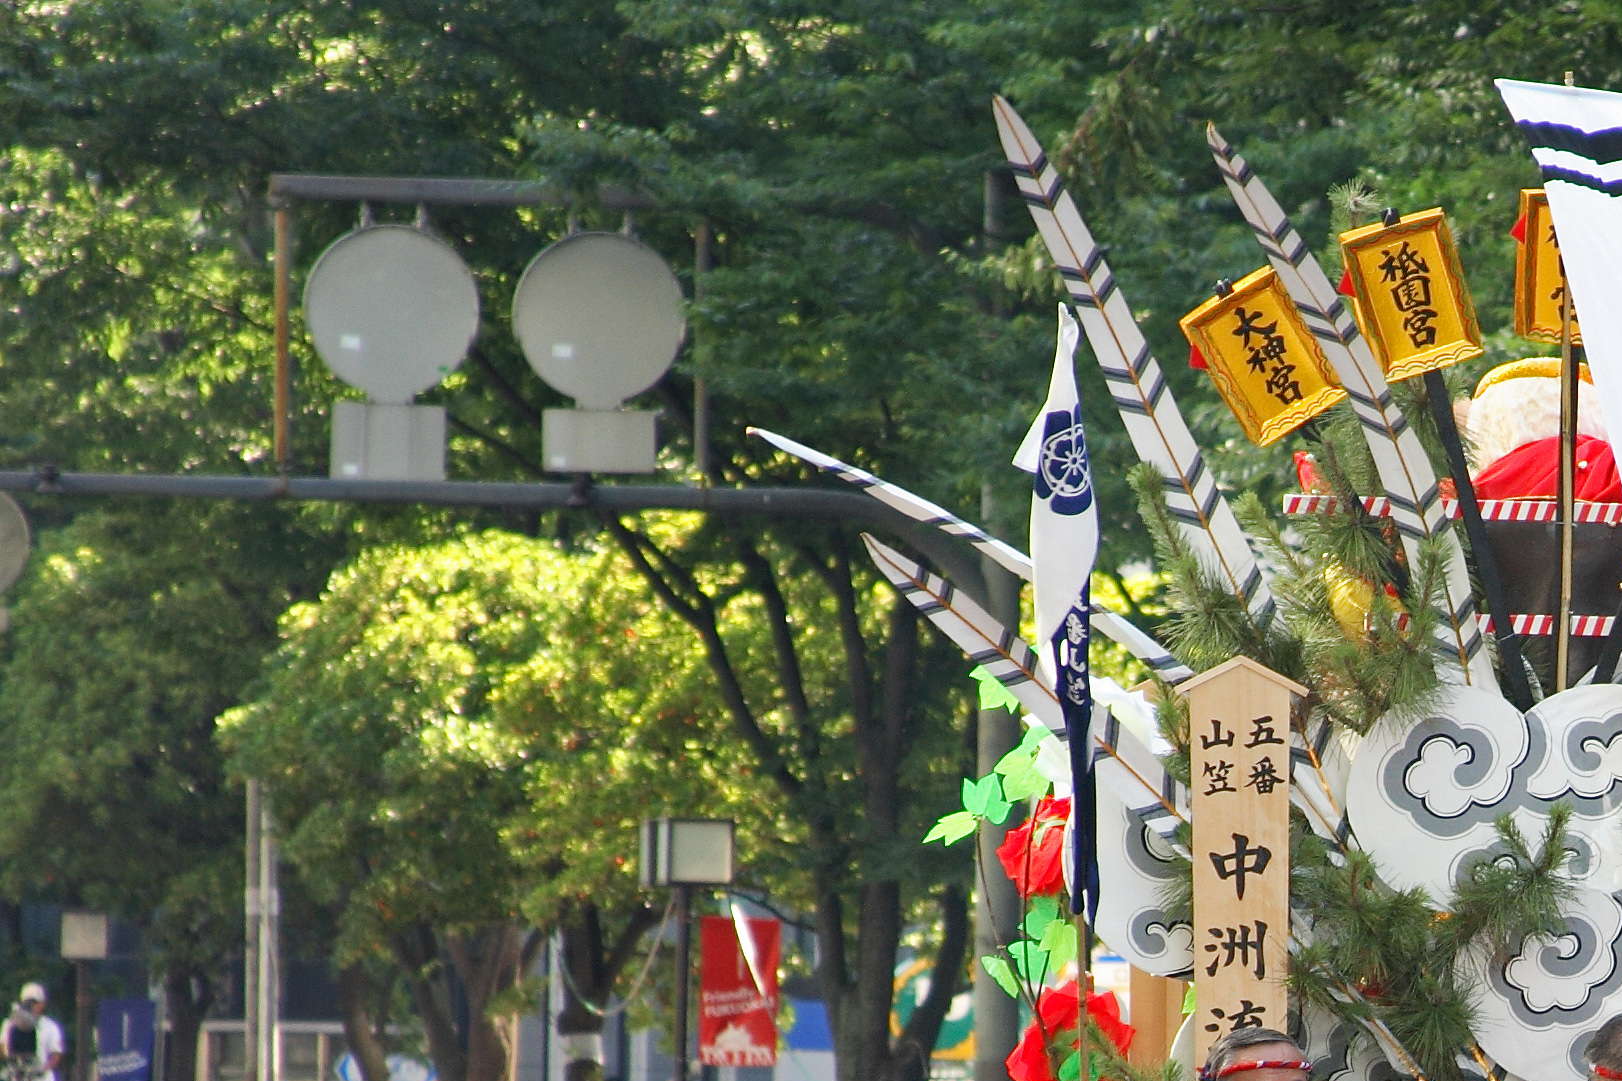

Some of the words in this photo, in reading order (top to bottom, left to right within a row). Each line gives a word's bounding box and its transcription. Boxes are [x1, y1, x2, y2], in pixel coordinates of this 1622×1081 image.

[1232, 307, 1303, 405] 大神宮
[1200, 719, 1237, 796] 山笠
[1244, 715, 1285, 795] 五番
